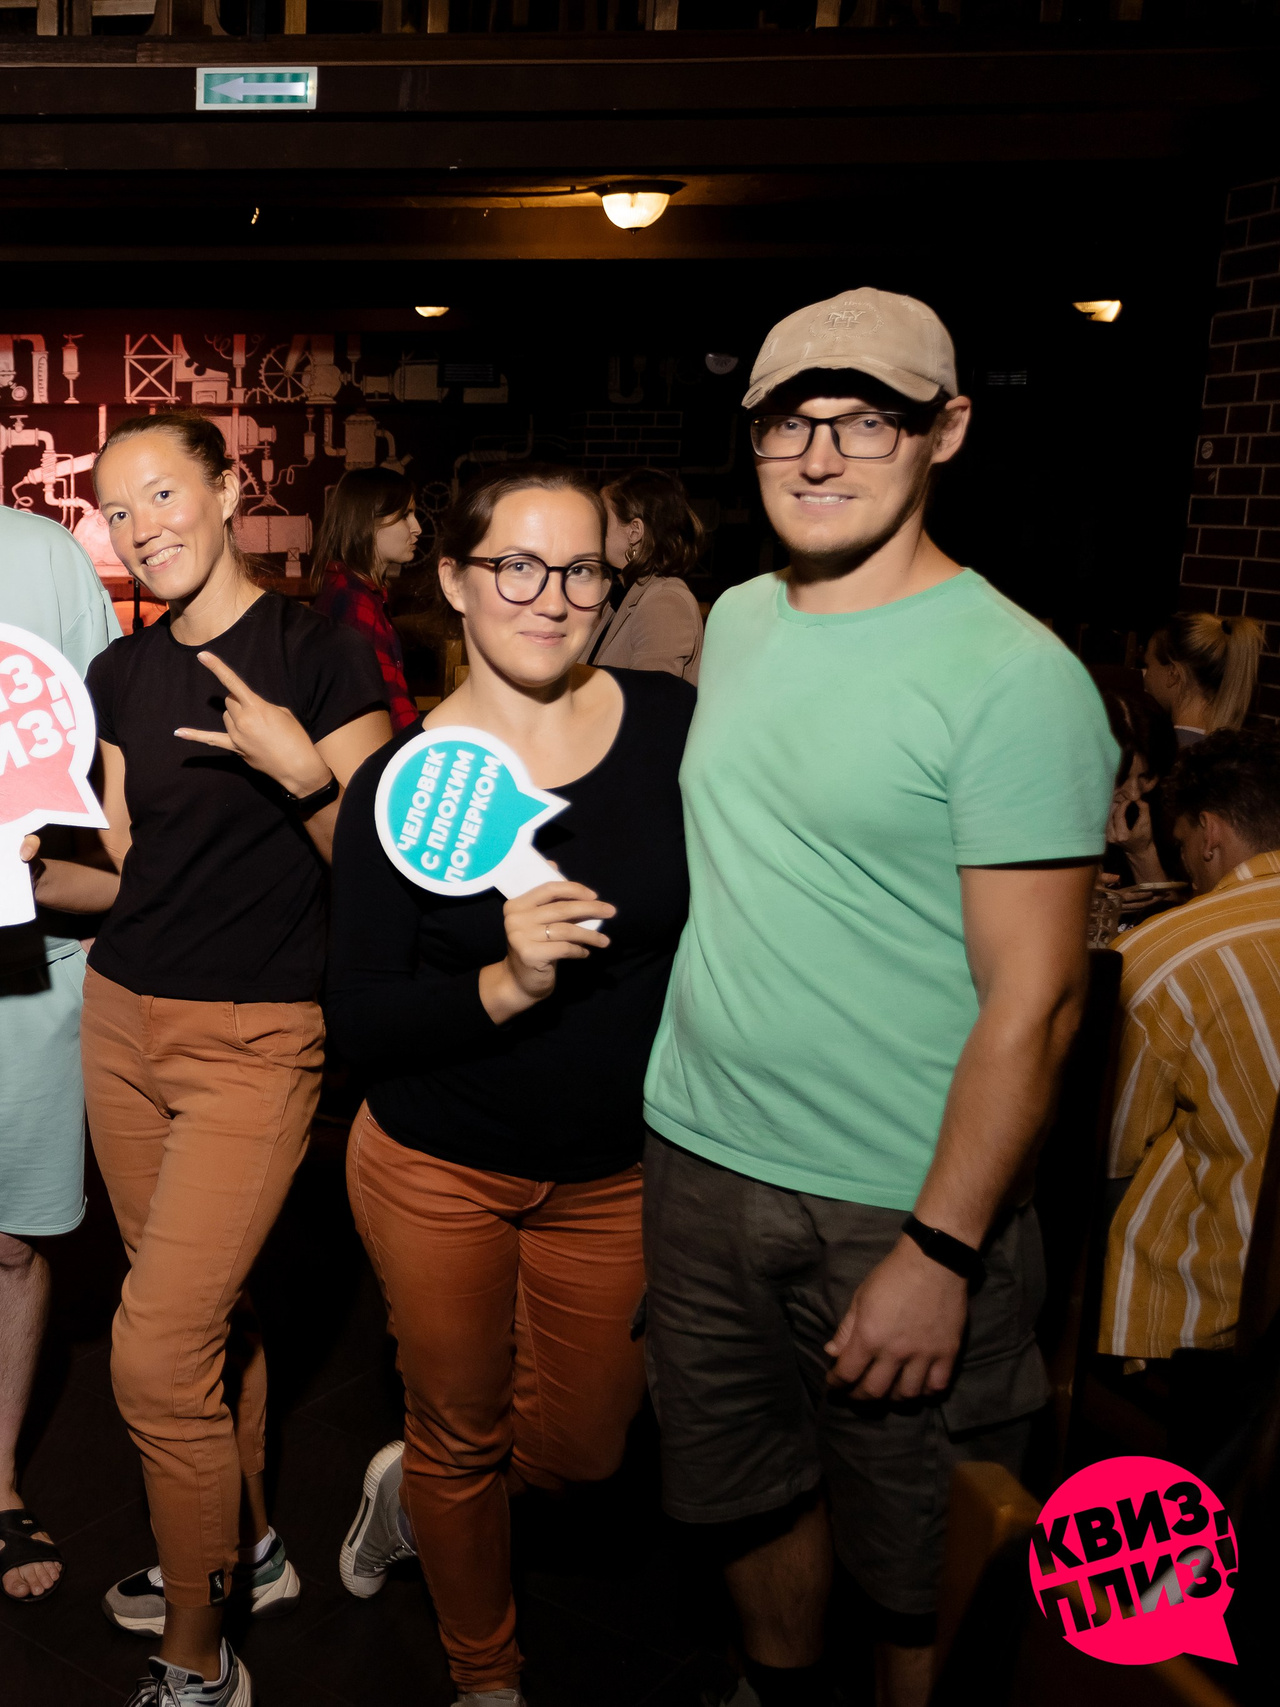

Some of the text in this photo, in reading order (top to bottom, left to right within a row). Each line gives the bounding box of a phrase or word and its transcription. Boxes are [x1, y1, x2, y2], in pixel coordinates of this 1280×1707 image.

[397, 748, 447, 851] ЧЕЛОВЕК
[420, 749, 476, 871] С ПЛОХИМ
[444, 755, 503, 883] ПОЧЕРКОМ
